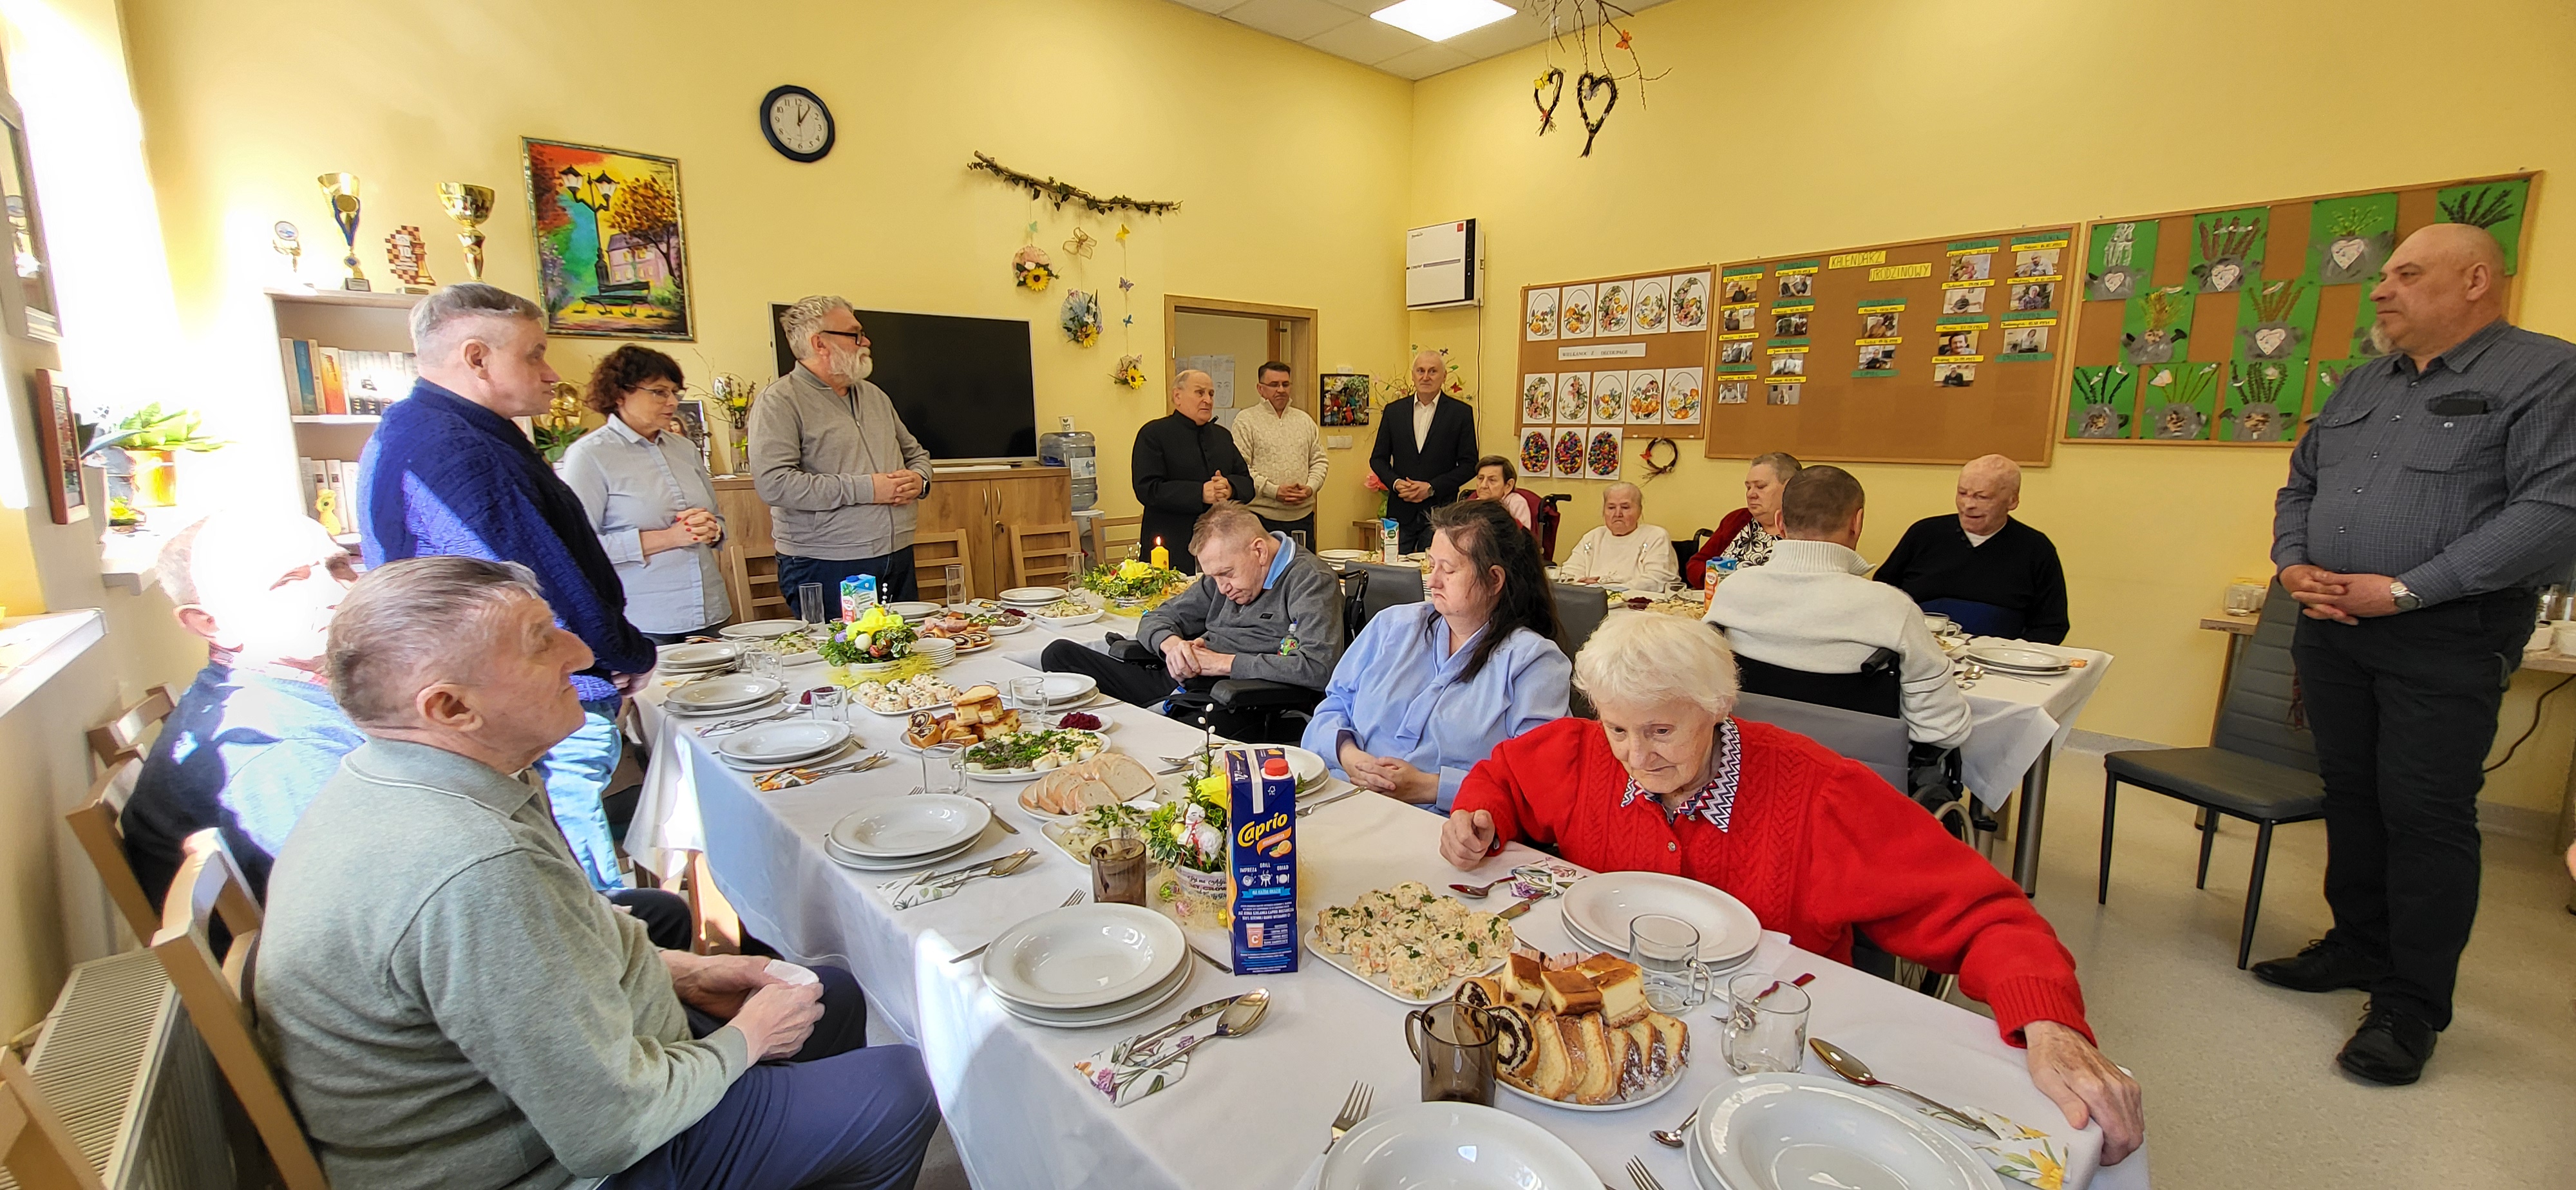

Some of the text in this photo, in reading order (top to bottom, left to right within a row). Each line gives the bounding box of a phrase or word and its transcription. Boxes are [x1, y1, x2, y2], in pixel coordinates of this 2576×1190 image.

[1831, 251, 1882, 267] KALENDARZ
[1870, 264, 1929, 280] URODZINOWY
[1238, 812, 1287, 847] Caprio
[1251, 935, 1259, 944] C
